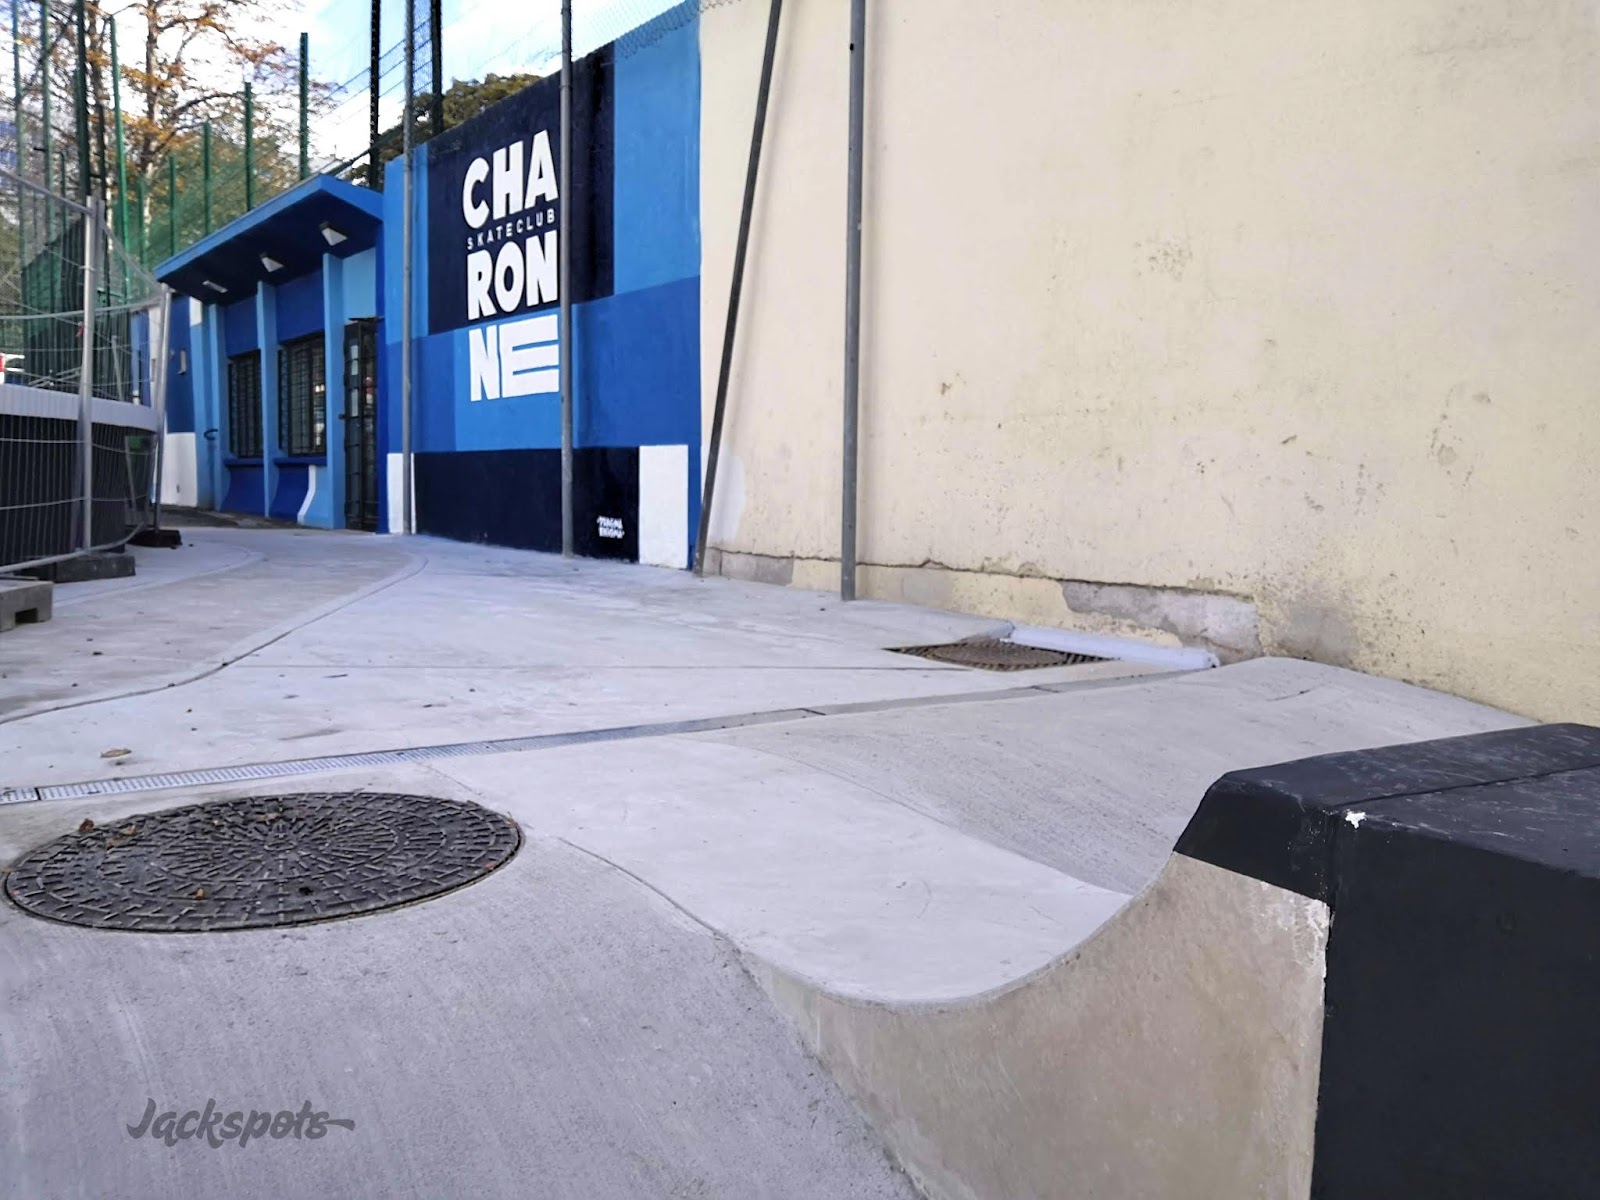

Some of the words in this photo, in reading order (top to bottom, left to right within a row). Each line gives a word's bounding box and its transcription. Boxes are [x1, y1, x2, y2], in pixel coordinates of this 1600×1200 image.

[463, 130, 559, 229] CHA
[467, 208, 555, 250] SKATECLUB
[467, 230, 558, 320] RON
[469, 314, 559, 402] NE
